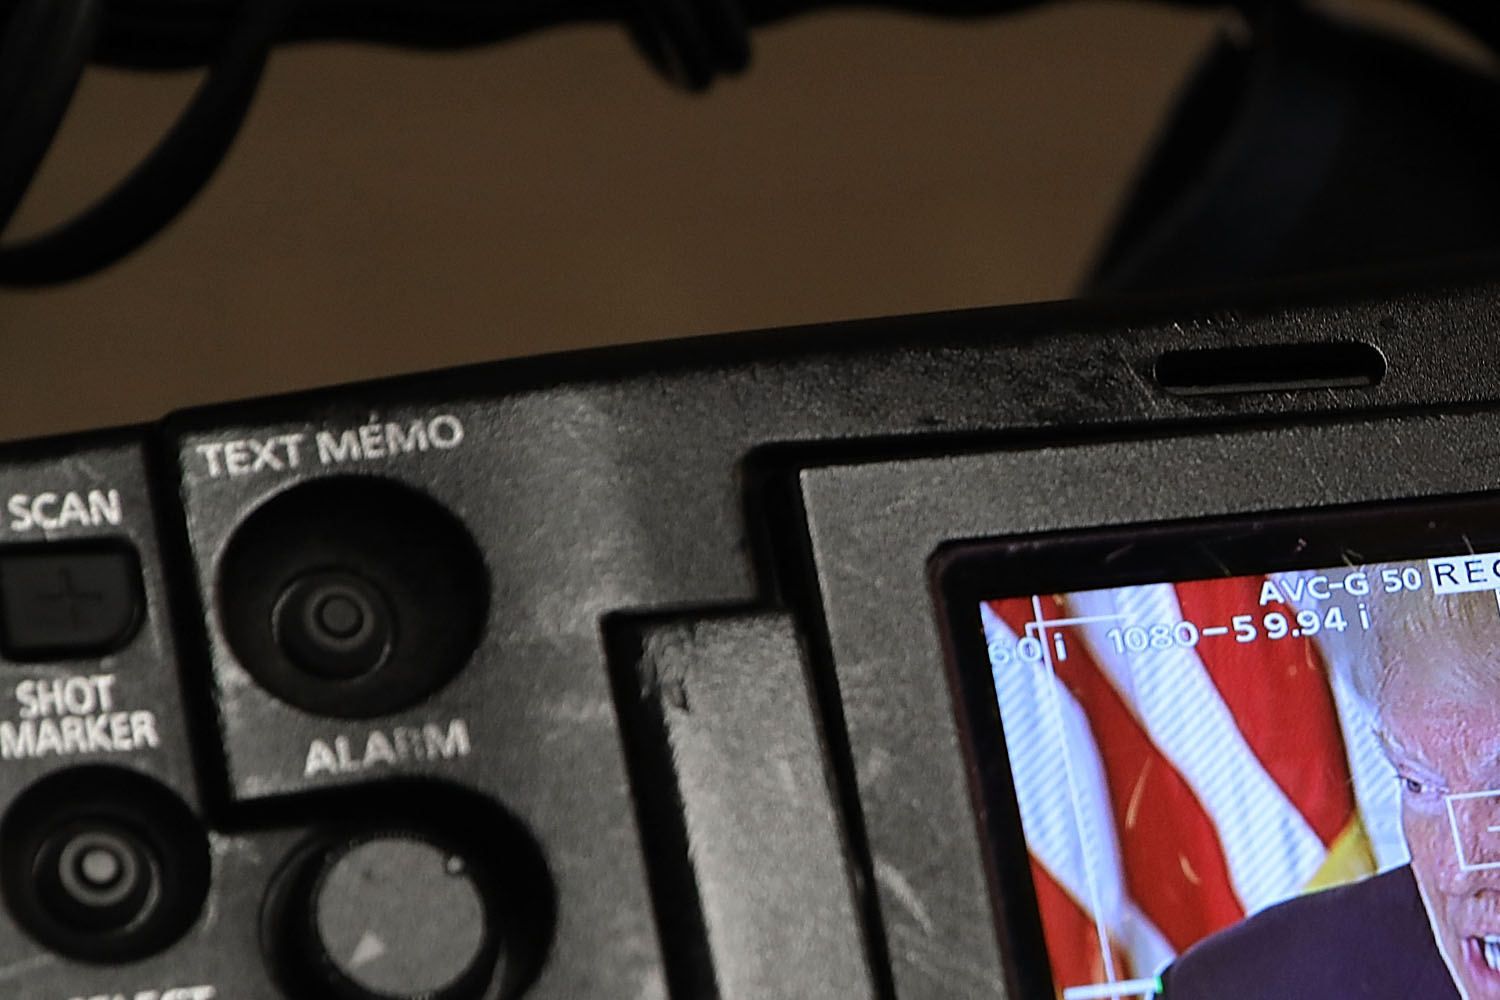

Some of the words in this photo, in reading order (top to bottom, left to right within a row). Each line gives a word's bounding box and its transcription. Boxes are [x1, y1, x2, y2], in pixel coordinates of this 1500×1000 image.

[199, 434, 305, 478] TEXT
[9, 489, 123, 532] SCAN
[1258, 572, 1371, 607] AVC-G
[1381, 566, 1423, 592] 50
[14, 675, 116, 719] SHOT
[0, 711, 160, 760] MARKER
[304, 719, 471, 776] ALARM
